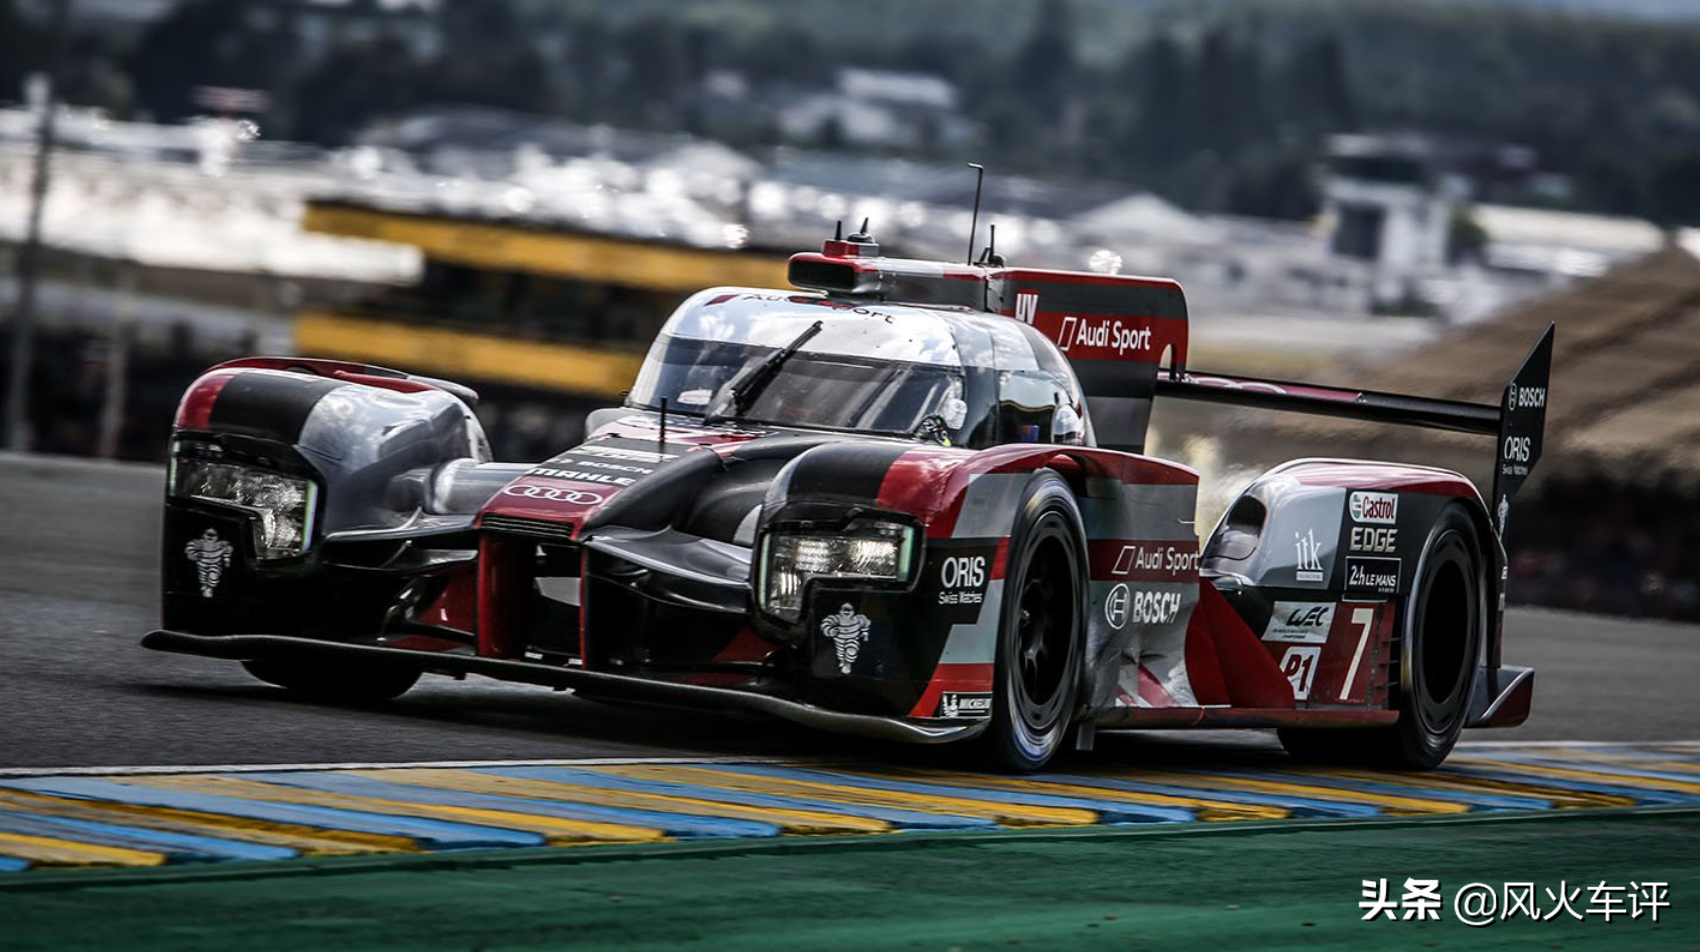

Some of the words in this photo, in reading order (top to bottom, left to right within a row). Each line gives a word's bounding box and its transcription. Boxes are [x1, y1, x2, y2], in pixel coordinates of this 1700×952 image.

[1076, 319, 1110, 347] Audi
[1111, 320, 1151, 356] Sport
[1518, 387, 1546, 408] BOSCH
[1504, 436, 1531, 462] ORIS
[524, 467, 637, 487] MAHLE
[577, 460, 653, 475] BOSCH
[1361, 495, 1396, 520] Castrol
[1295, 528, 1323, 570] itk
[1350, 526, 1398, 553] EDGE
[941, 556, 986, 588] ORIS
[1134, 546, 1164, 569] Audi
[1165, 546, 1199, 576] Sport
[1375, 574, 1397, 587] MANS
[1132, 590, 1181, 624] BOSCH
[1286, 606, 1329, 627] WEC
[1339, 608, 1374, 700] 7
[1283, 654, 1314, 692] P1
